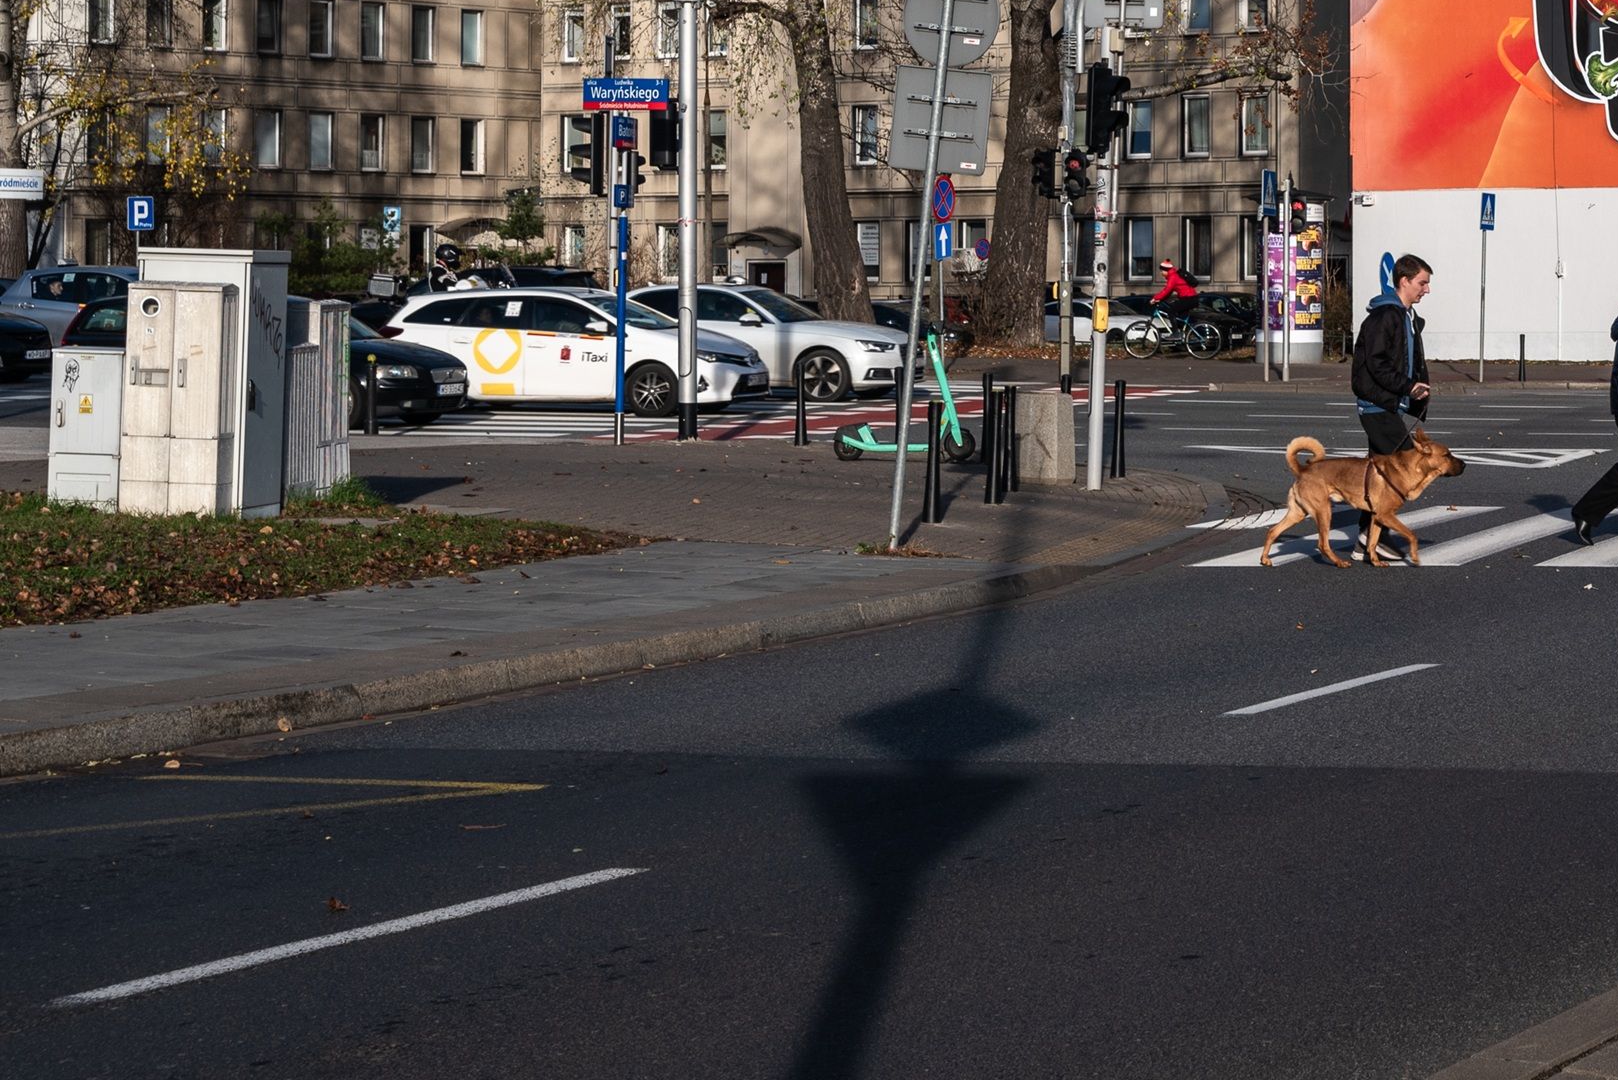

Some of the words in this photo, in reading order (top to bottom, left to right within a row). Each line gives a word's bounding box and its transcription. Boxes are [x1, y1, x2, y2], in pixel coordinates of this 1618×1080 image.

[590, 86, 660, 102] Waryńskiego
[0, 176, 39, 188] ródmieście
[134, 200, 149, 226] P
[581, 351, 608, 362] iTaxi
